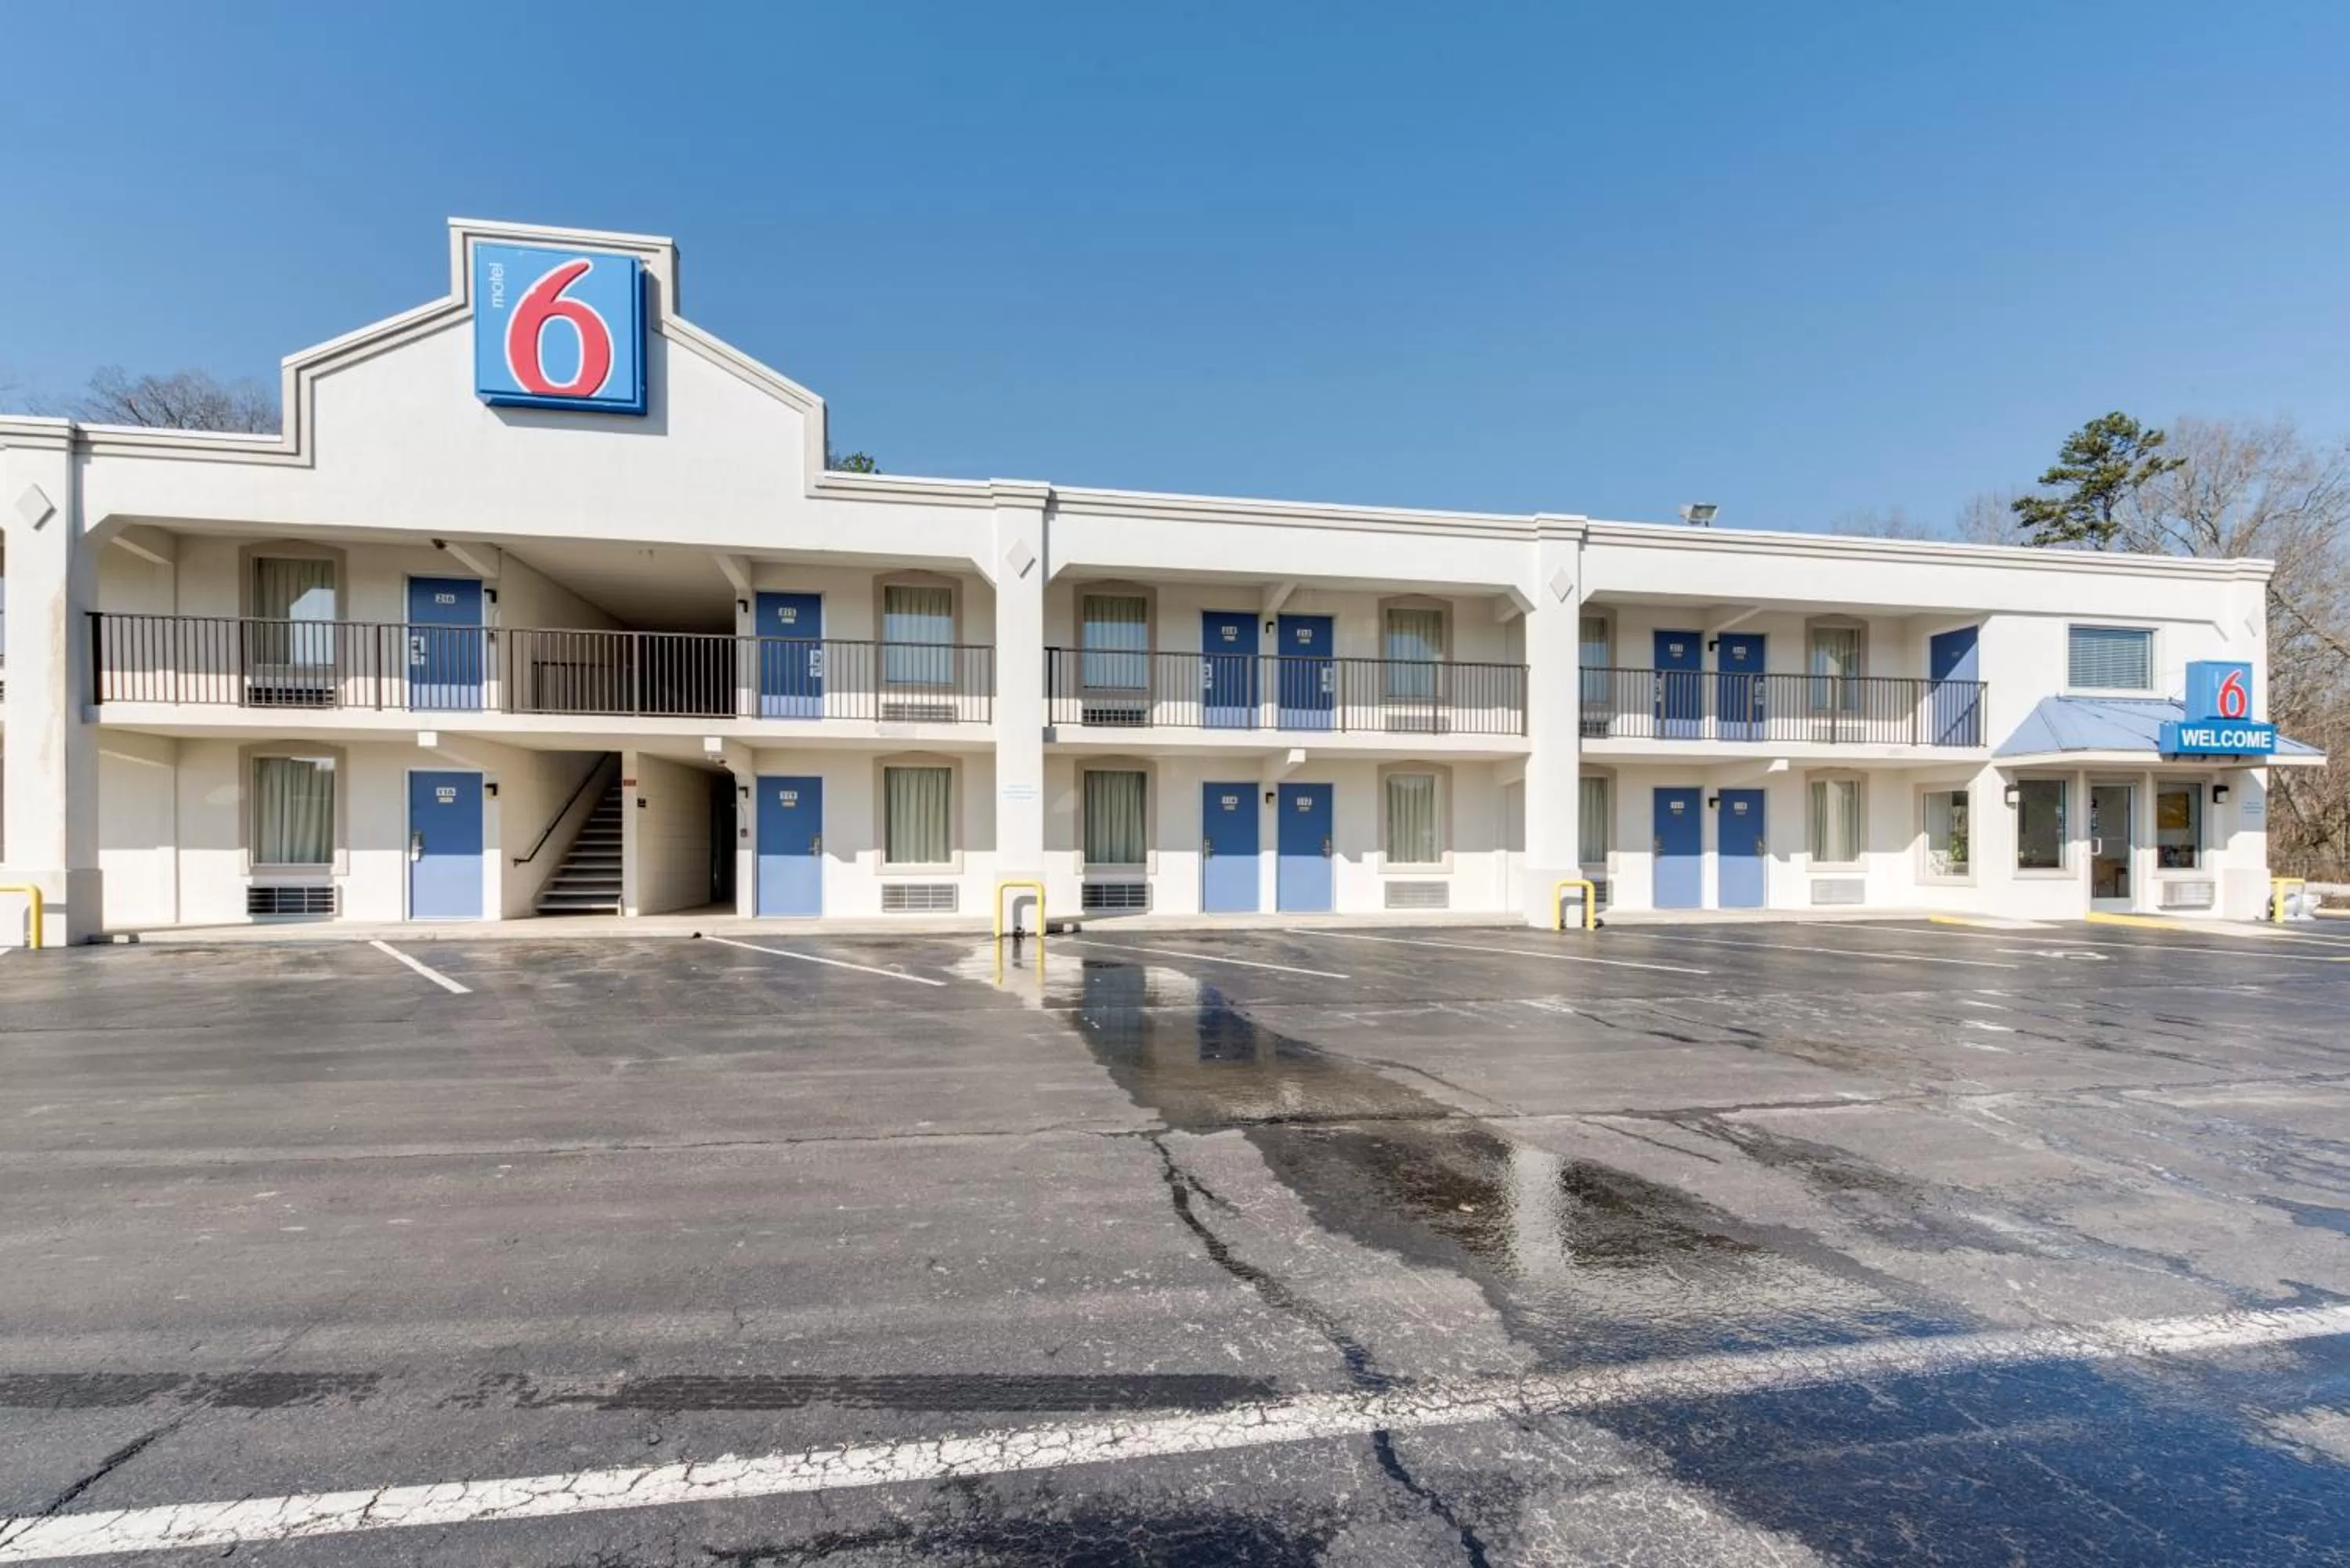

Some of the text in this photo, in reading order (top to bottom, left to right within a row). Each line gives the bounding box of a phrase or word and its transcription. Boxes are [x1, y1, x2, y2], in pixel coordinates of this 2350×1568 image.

[488, 262, 504, 309] motel
[504, 258, 614, 398] 6
[2218, 669, 2247, 718] 6
[2181, 728, 2272, 749] WELCOME
